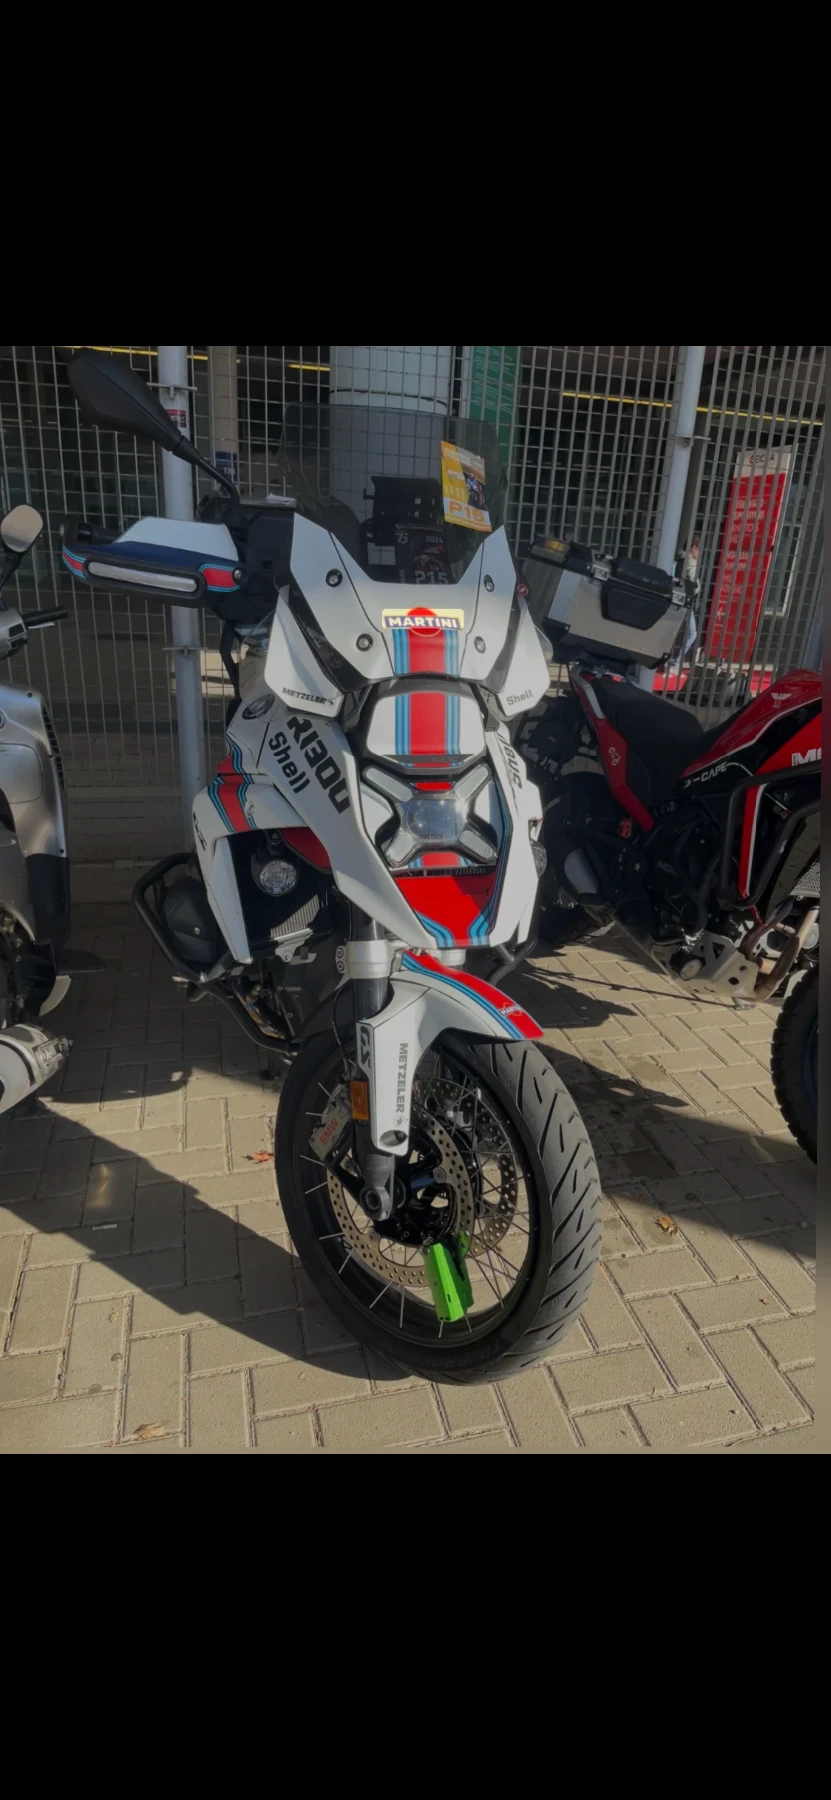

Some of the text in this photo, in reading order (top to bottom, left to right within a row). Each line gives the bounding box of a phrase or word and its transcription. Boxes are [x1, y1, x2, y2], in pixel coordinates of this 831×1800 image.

[448, 501, 487, 523] P15
[425, 535, 444, 544] 2024
[414, 570, 449, 584] P15
[387, 616, 458, 629] MARTINI
[282, 687, 327, 705] METZELER
[506, 689, 533, 706] Shell
[268, 731, 311, 794] Shell
[395, 1042, 409, 1113] METZELER
[320, 1118, 338, 1145] BMW
